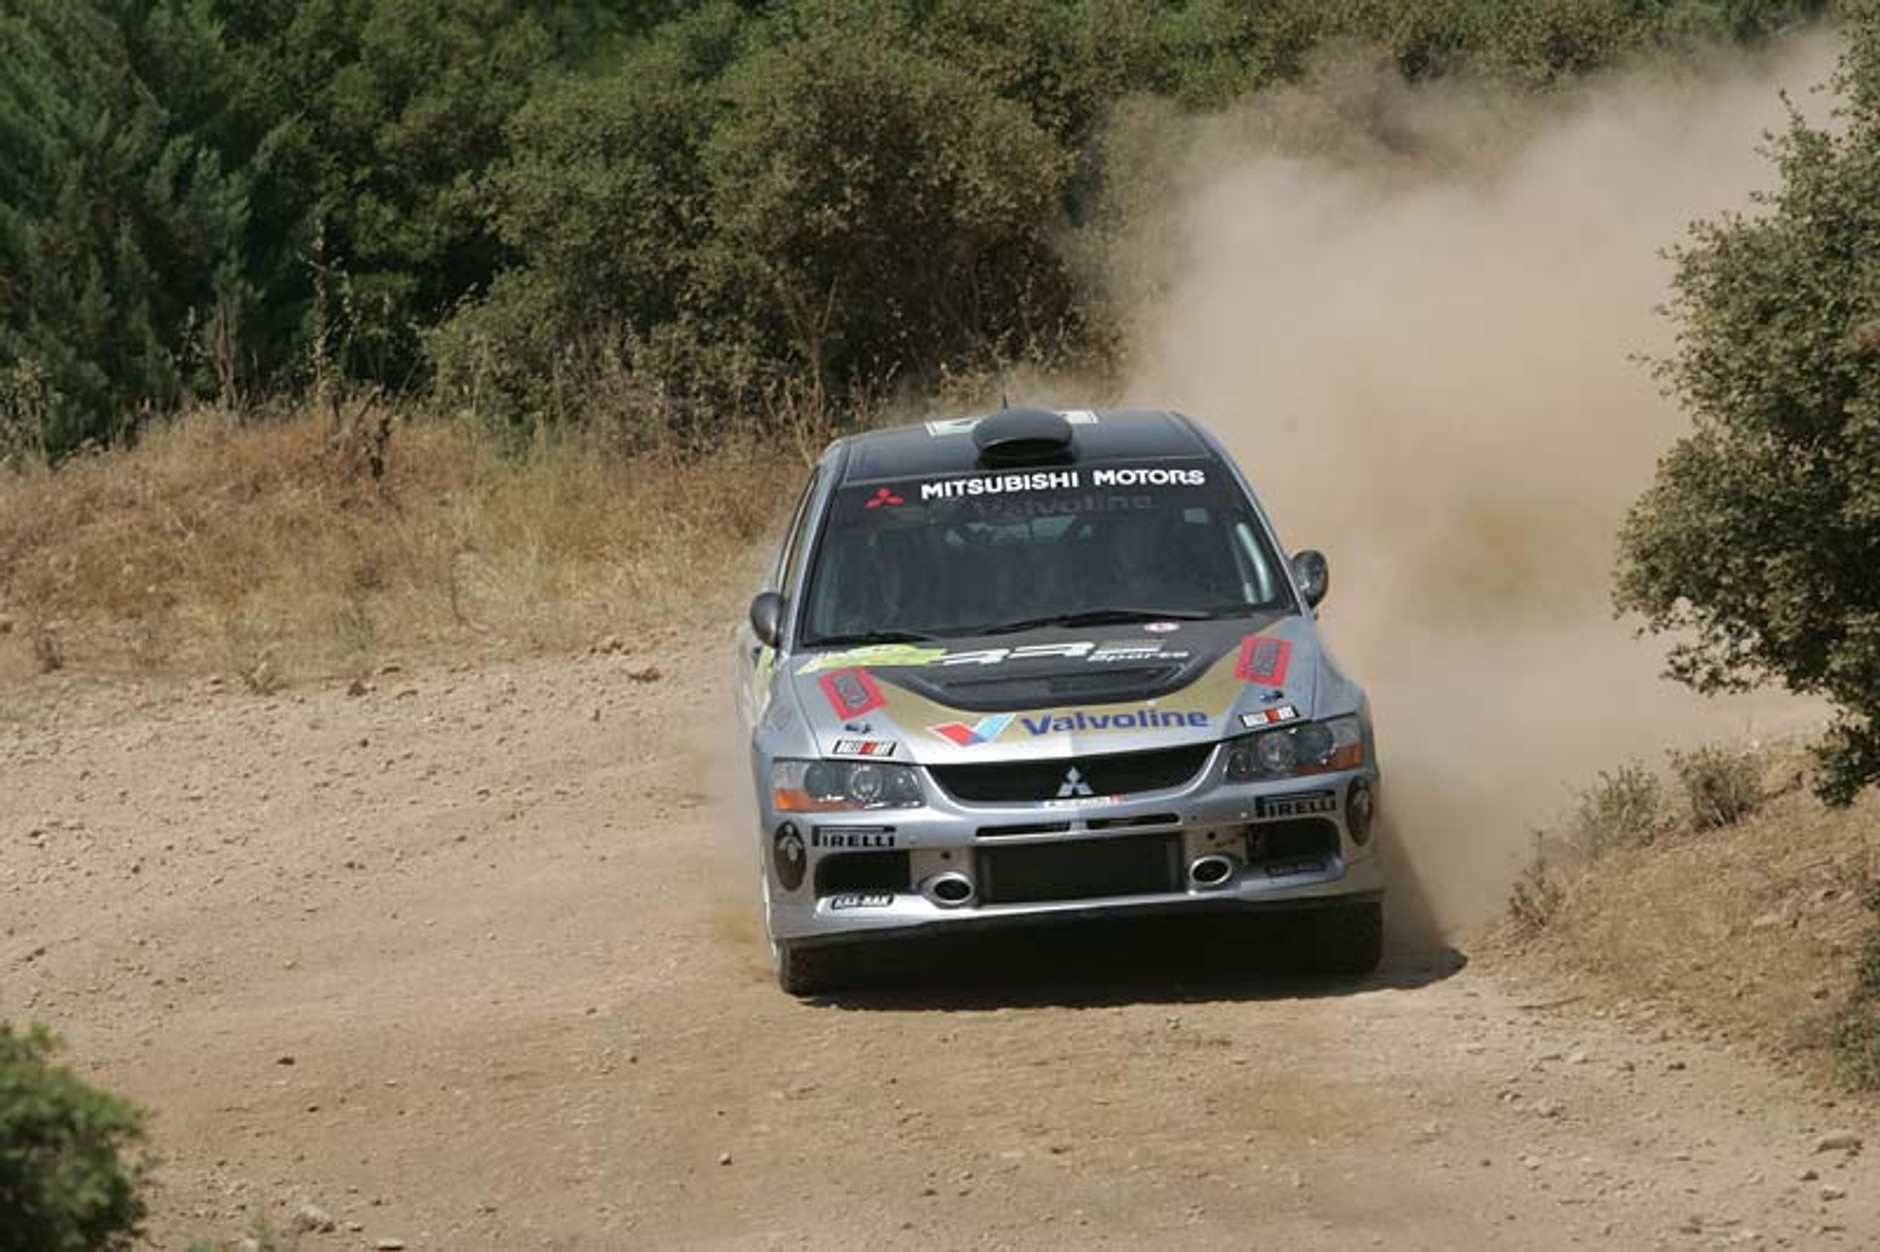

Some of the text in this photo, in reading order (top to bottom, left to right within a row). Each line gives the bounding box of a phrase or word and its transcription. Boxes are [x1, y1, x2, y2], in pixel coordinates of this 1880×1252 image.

[921, 469, 1206, 499] MITSUBISHI MOTORS
[1021, 710, 1210, 736] Valvoline
[1254, 789, 1337, 819] PIRELLI
[811, 825, 897, 847] PIRELLI
